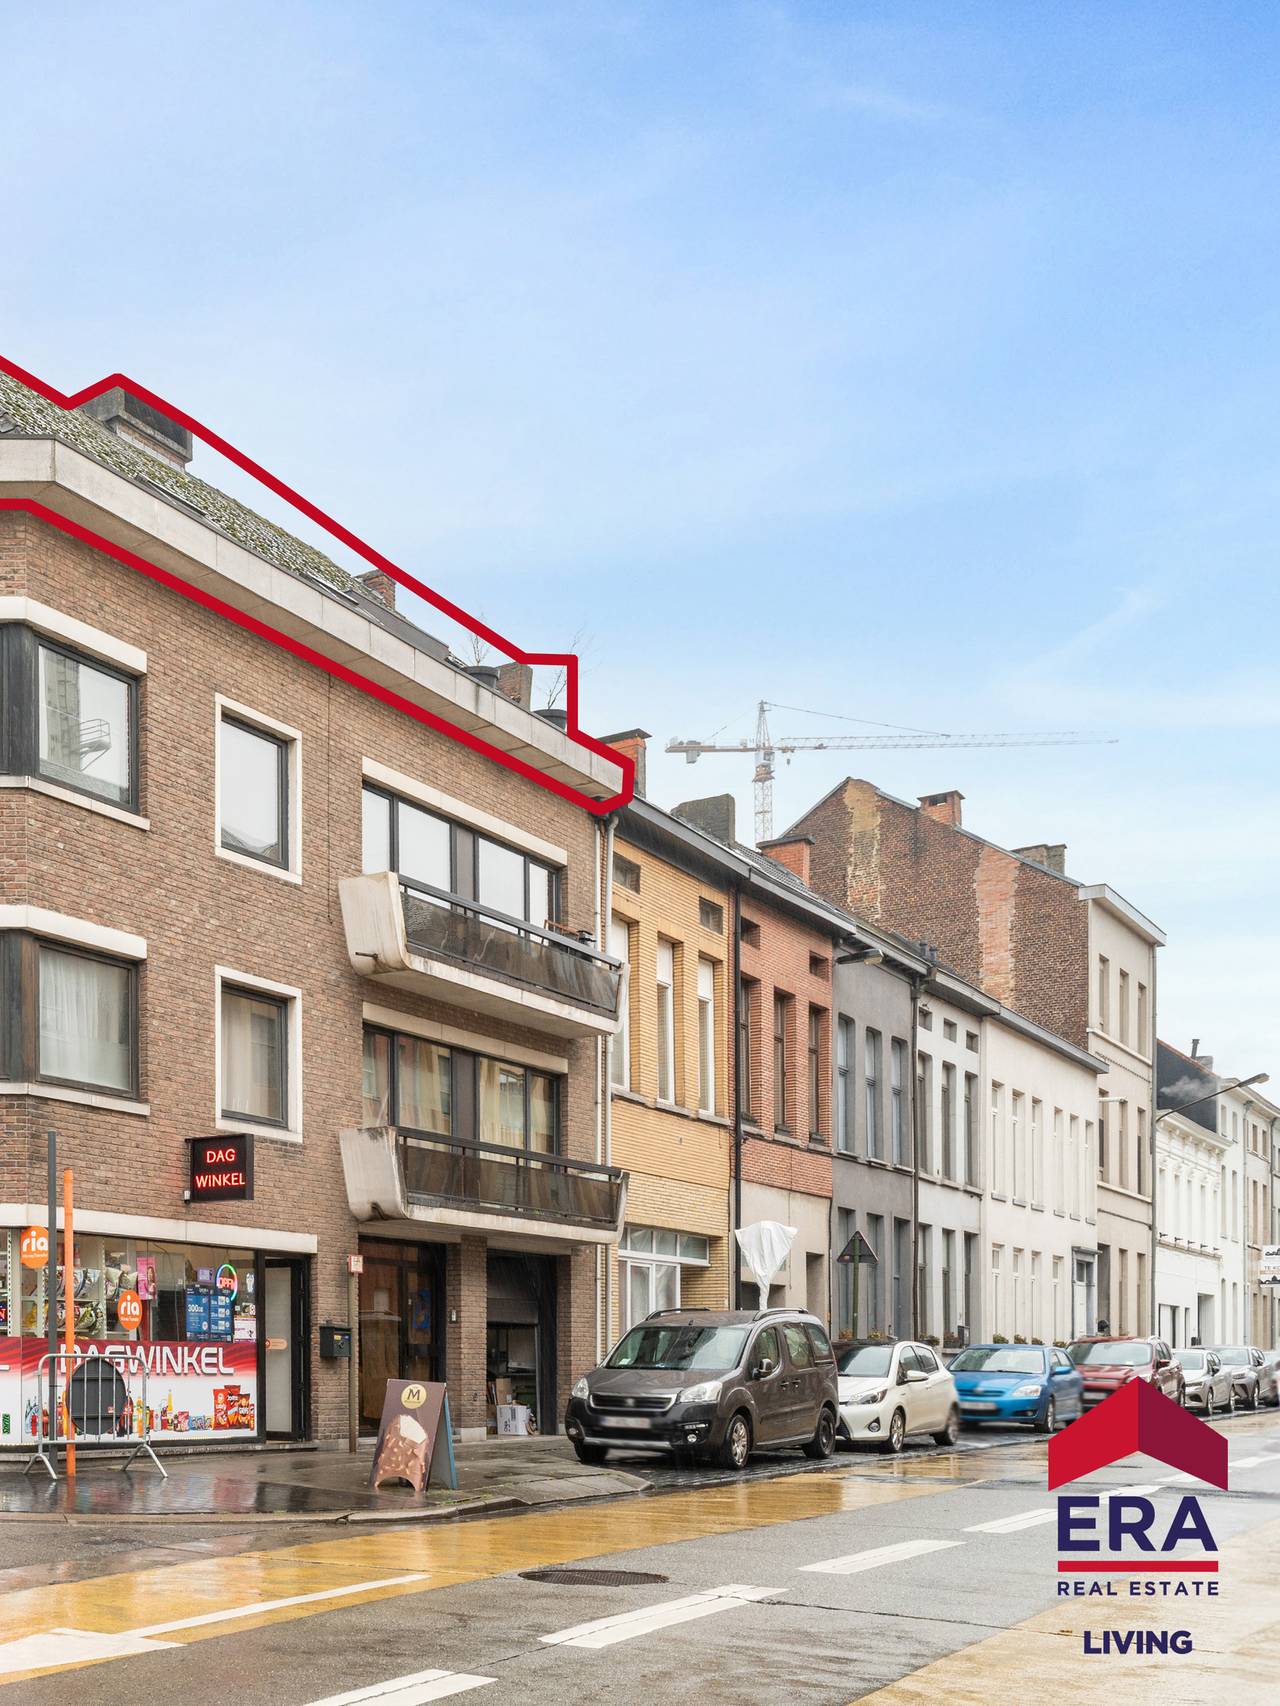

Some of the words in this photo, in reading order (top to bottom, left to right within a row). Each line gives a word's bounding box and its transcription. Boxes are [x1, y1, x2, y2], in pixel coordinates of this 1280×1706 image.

[206, 1148, 236, 1163] DAG
[195, 1172, 246, 1188] WINKEL
[22, 1230, 49, 1252] ria
[120, 1294, 140, 1316] ria
